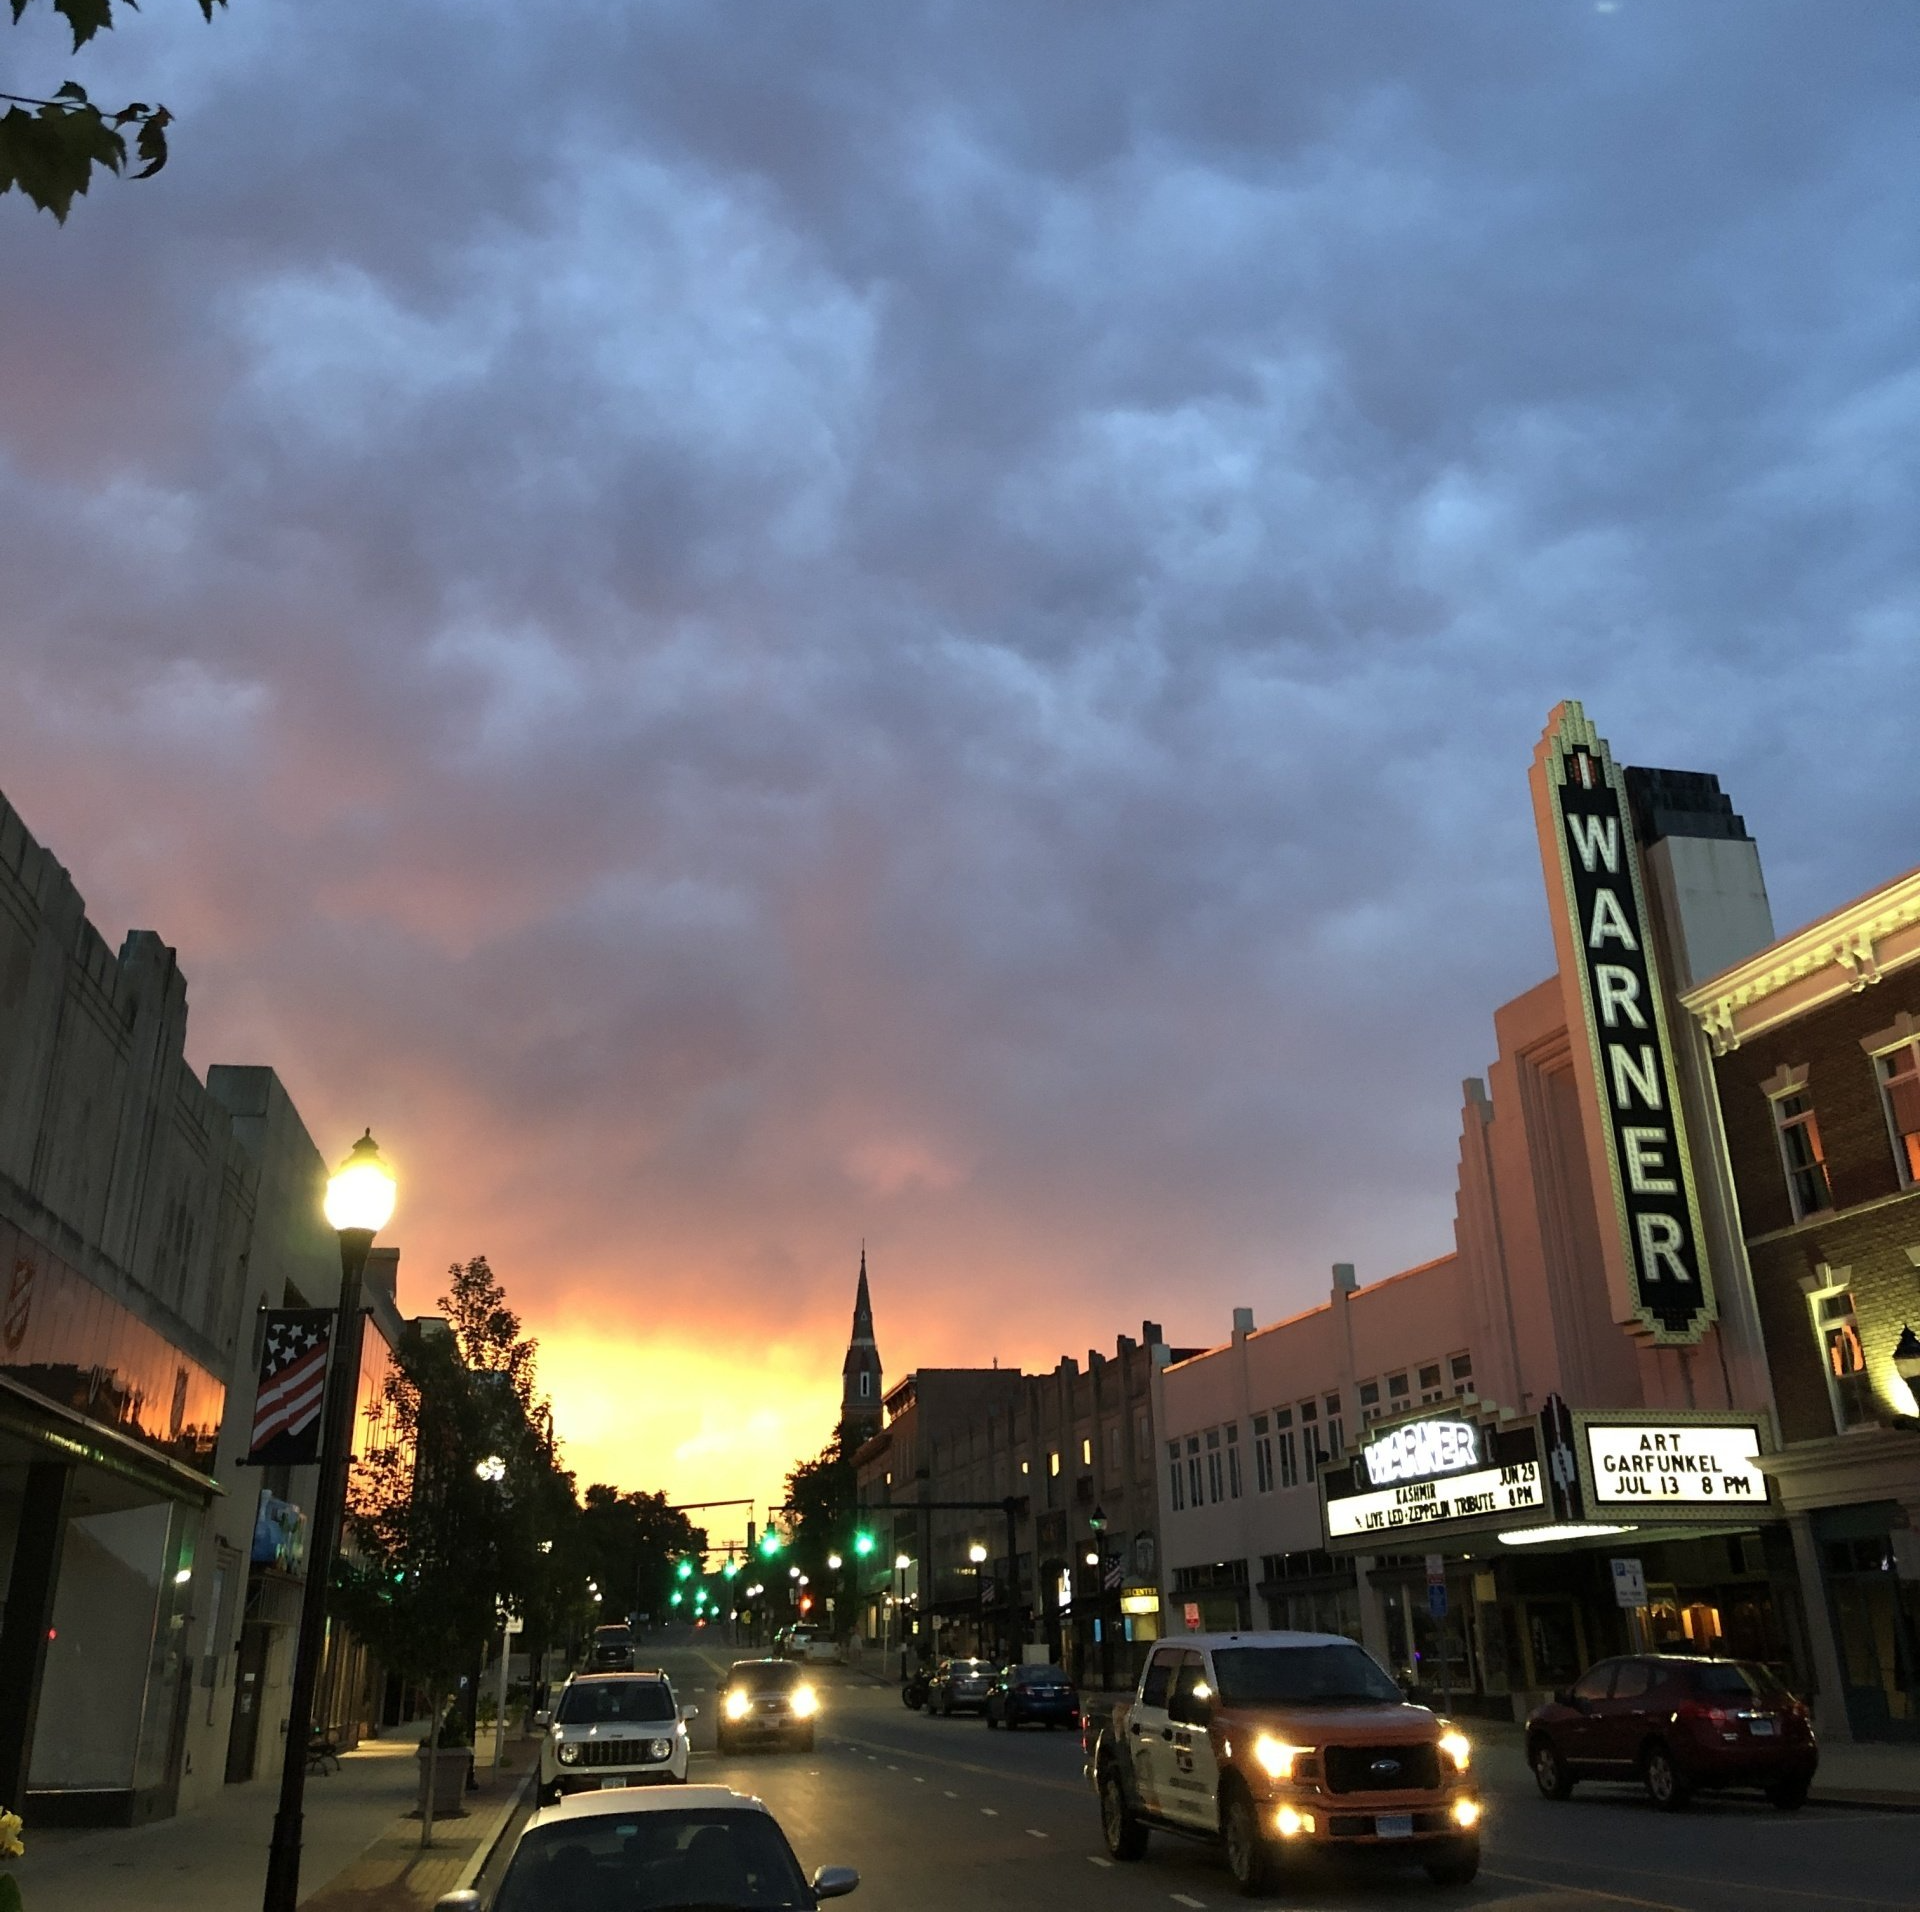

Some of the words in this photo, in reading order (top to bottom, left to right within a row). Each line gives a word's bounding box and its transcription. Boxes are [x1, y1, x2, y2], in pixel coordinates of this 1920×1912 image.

[1566, 812, 1690, 1284] WARNER
[1364, 1421, 1477, 1484] WARNER
[1640, 1434, 1681, 1452] ART
[1499, 1465, 1519, 1486] JUN
[1521, 1462, 1535, 1482] 29
[1603, 1454, 1723, 1473] GARFUNKEL
[1396, 1483, 1437, 1505] KASHMIR
[1508, 1488, 1516, 1507] 8
[1516, 1485, 1533, 1505] PM
[1614, 1476, 1652, 1495] JUL
[1661, 1476, 1680, 1495] 13
[1702, 1476, 1713, 1495] 8
[1723, 1476, 1751, 1495] PM
[1365, 1511, 1385, 1529] LIVE
[1408, 1500, 1451, 1523] ZEPPELIN
[1454, 1492, 1496, 1516] TRIBUTE
